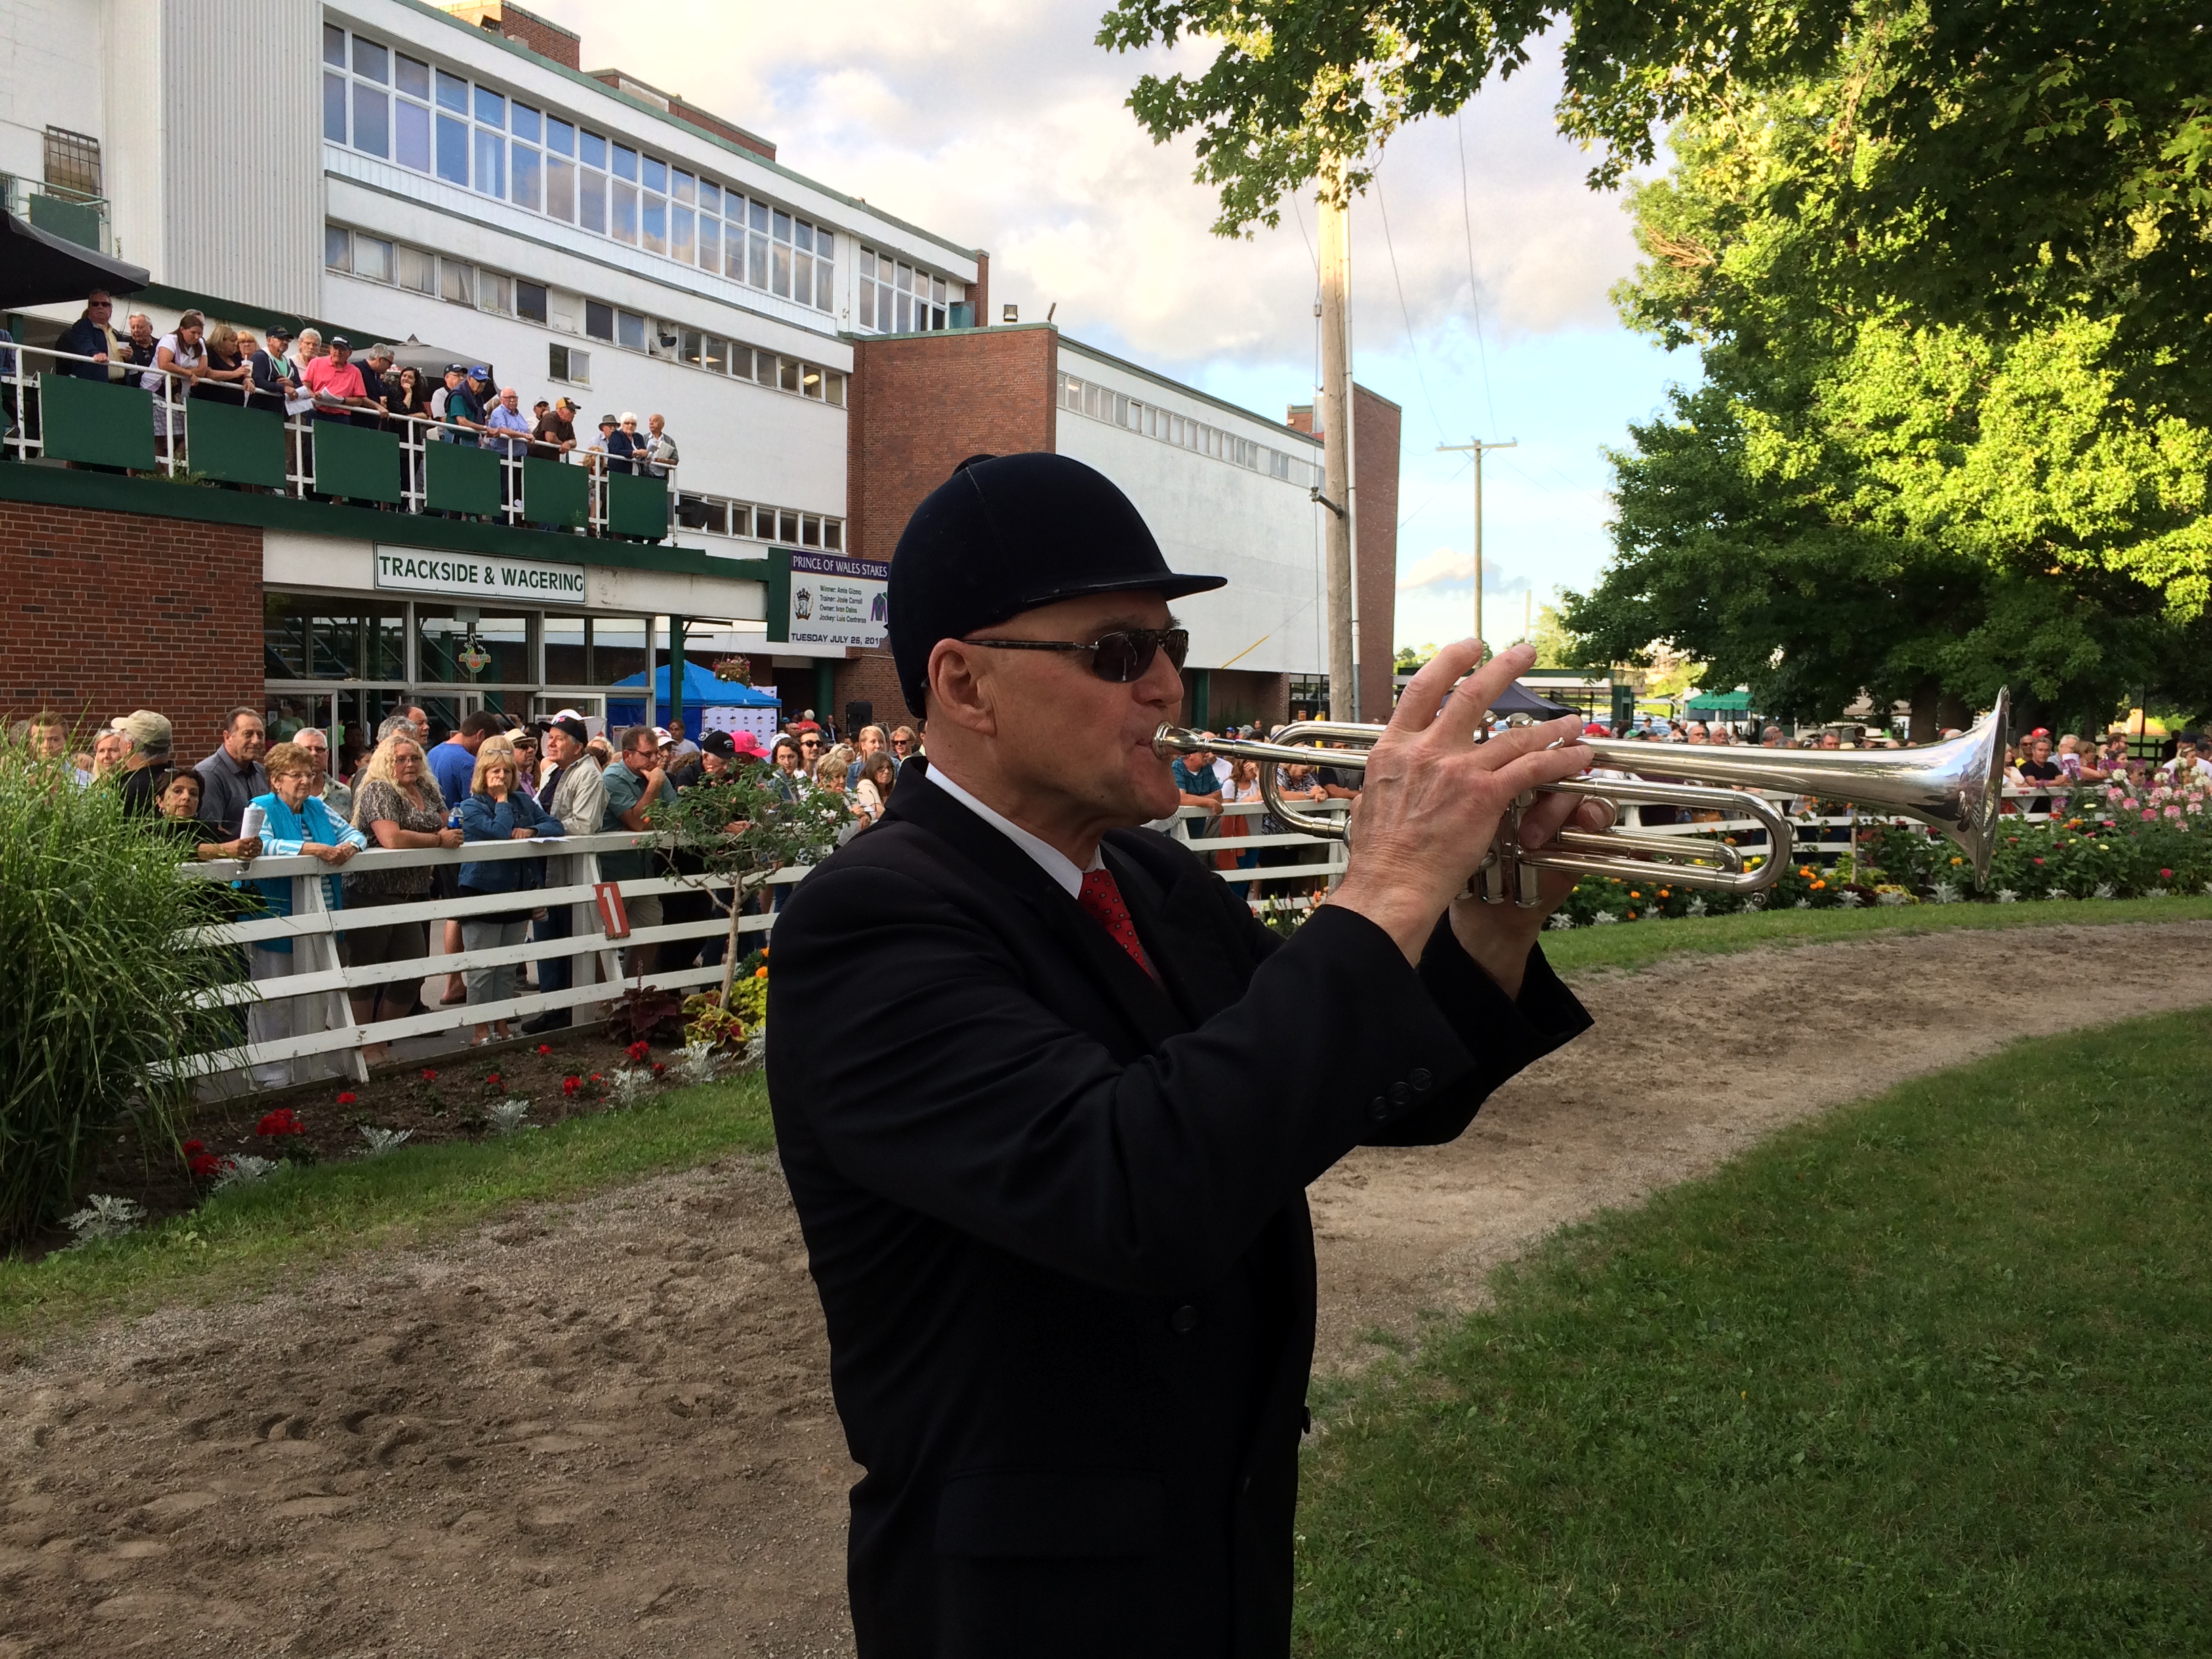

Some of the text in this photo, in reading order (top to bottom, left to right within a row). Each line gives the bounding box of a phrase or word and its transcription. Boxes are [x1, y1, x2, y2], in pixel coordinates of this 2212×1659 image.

[793, 555, 888, 577] PRINCE OF WALES STAKES
[379, 556, 583, 592] TRACKSIDE & WAGERING
[820, 585, 836, 593] Winner:
[848, 588, 862, 596] Gizmo
[820, 594, 836, 602] Trainer:
[819, 614, 836, 623] Jockey:
[846, 616, 867, 624] Contreras
[791, 633, 828, 642] TUESDAY
[851, 636, 863, 645] 26,
[603, 886, 622, 934] 1
